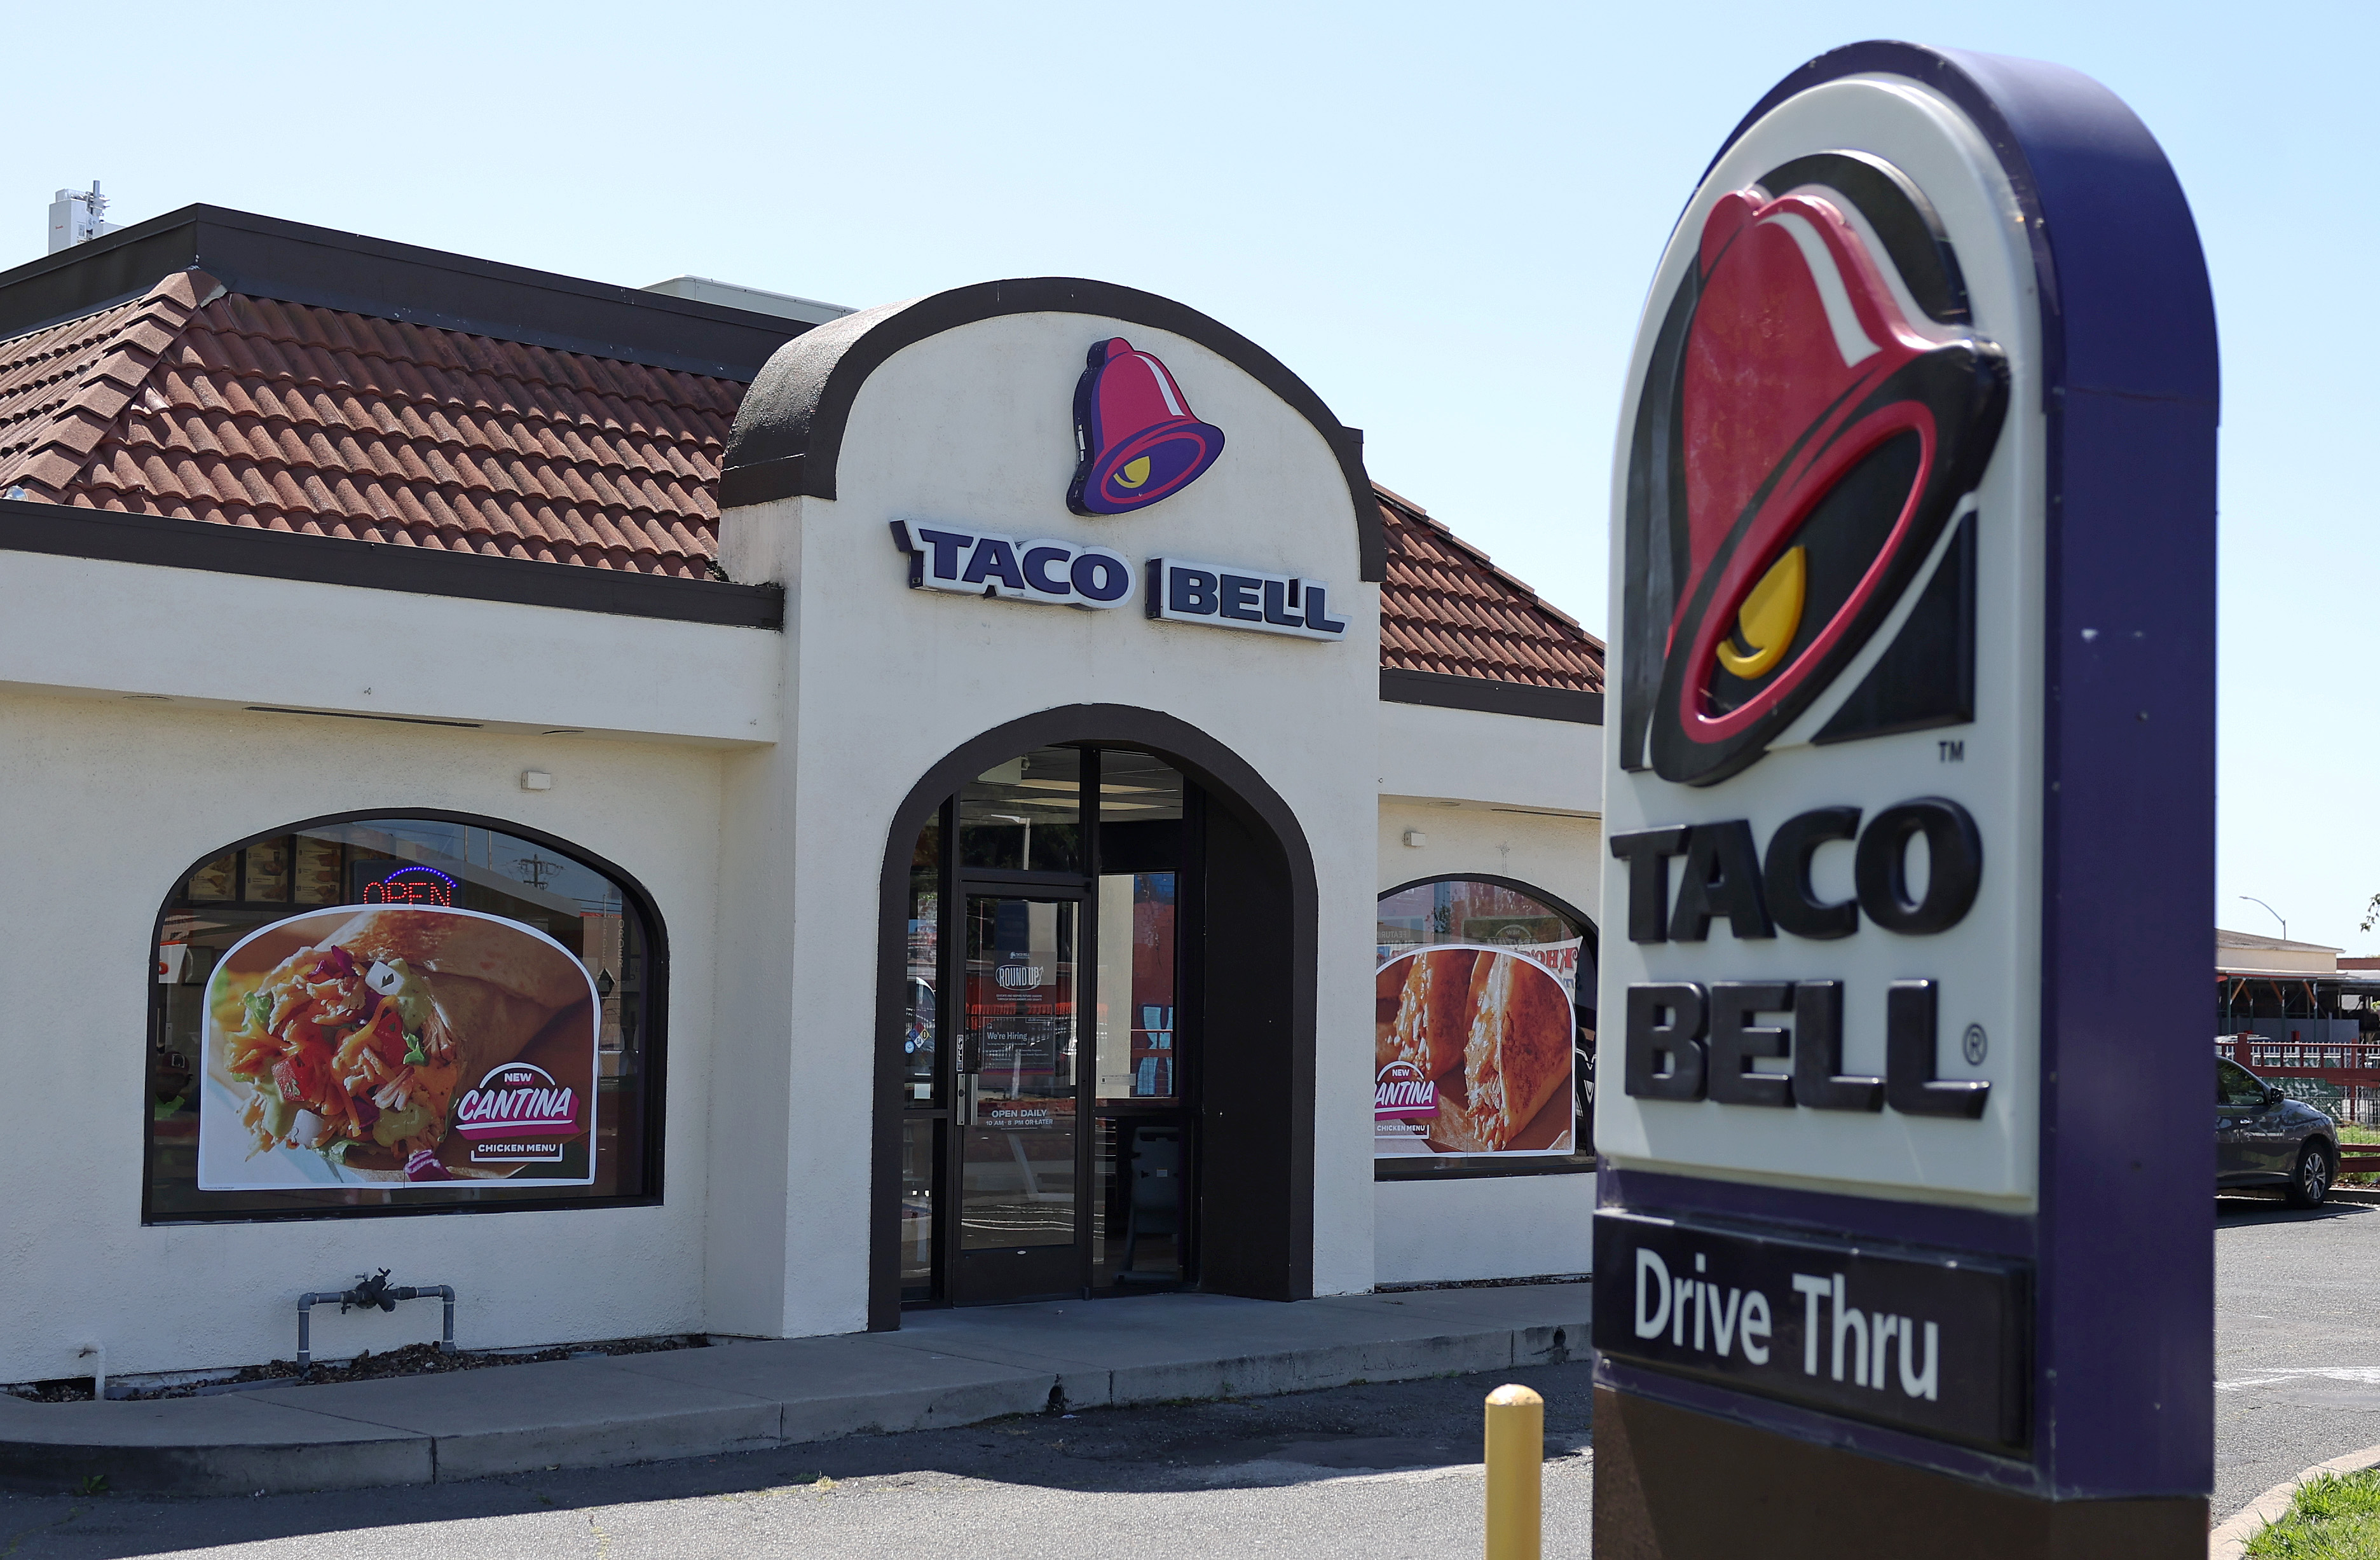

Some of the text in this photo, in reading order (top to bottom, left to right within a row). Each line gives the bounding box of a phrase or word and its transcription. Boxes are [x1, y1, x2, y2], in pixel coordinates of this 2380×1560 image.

[919, 528, 1344, 633] TACO BELL
[1938, 741, 1964, 762] TM
[1610, 797, 1983, 943] TACO
[363, 881, 451, 908] OPEN
[999, 966, 1040, 987] ROUND UP
[922, 1030, 927, 1039] 0
[987, 1032, 1027, 1041] We're Hiring
[1625, 979, 1990, 1119] BELL
[504, 1072, 532, 1083] NEW
[457, 1087, 572, 1121] CANTINA
[1374, 1080, 1435, 1106] ANTINA
[478, 1144, 556, 1153] CHICKEN MENU
[1635, 1247, 1938, 1401] Drive Thru
